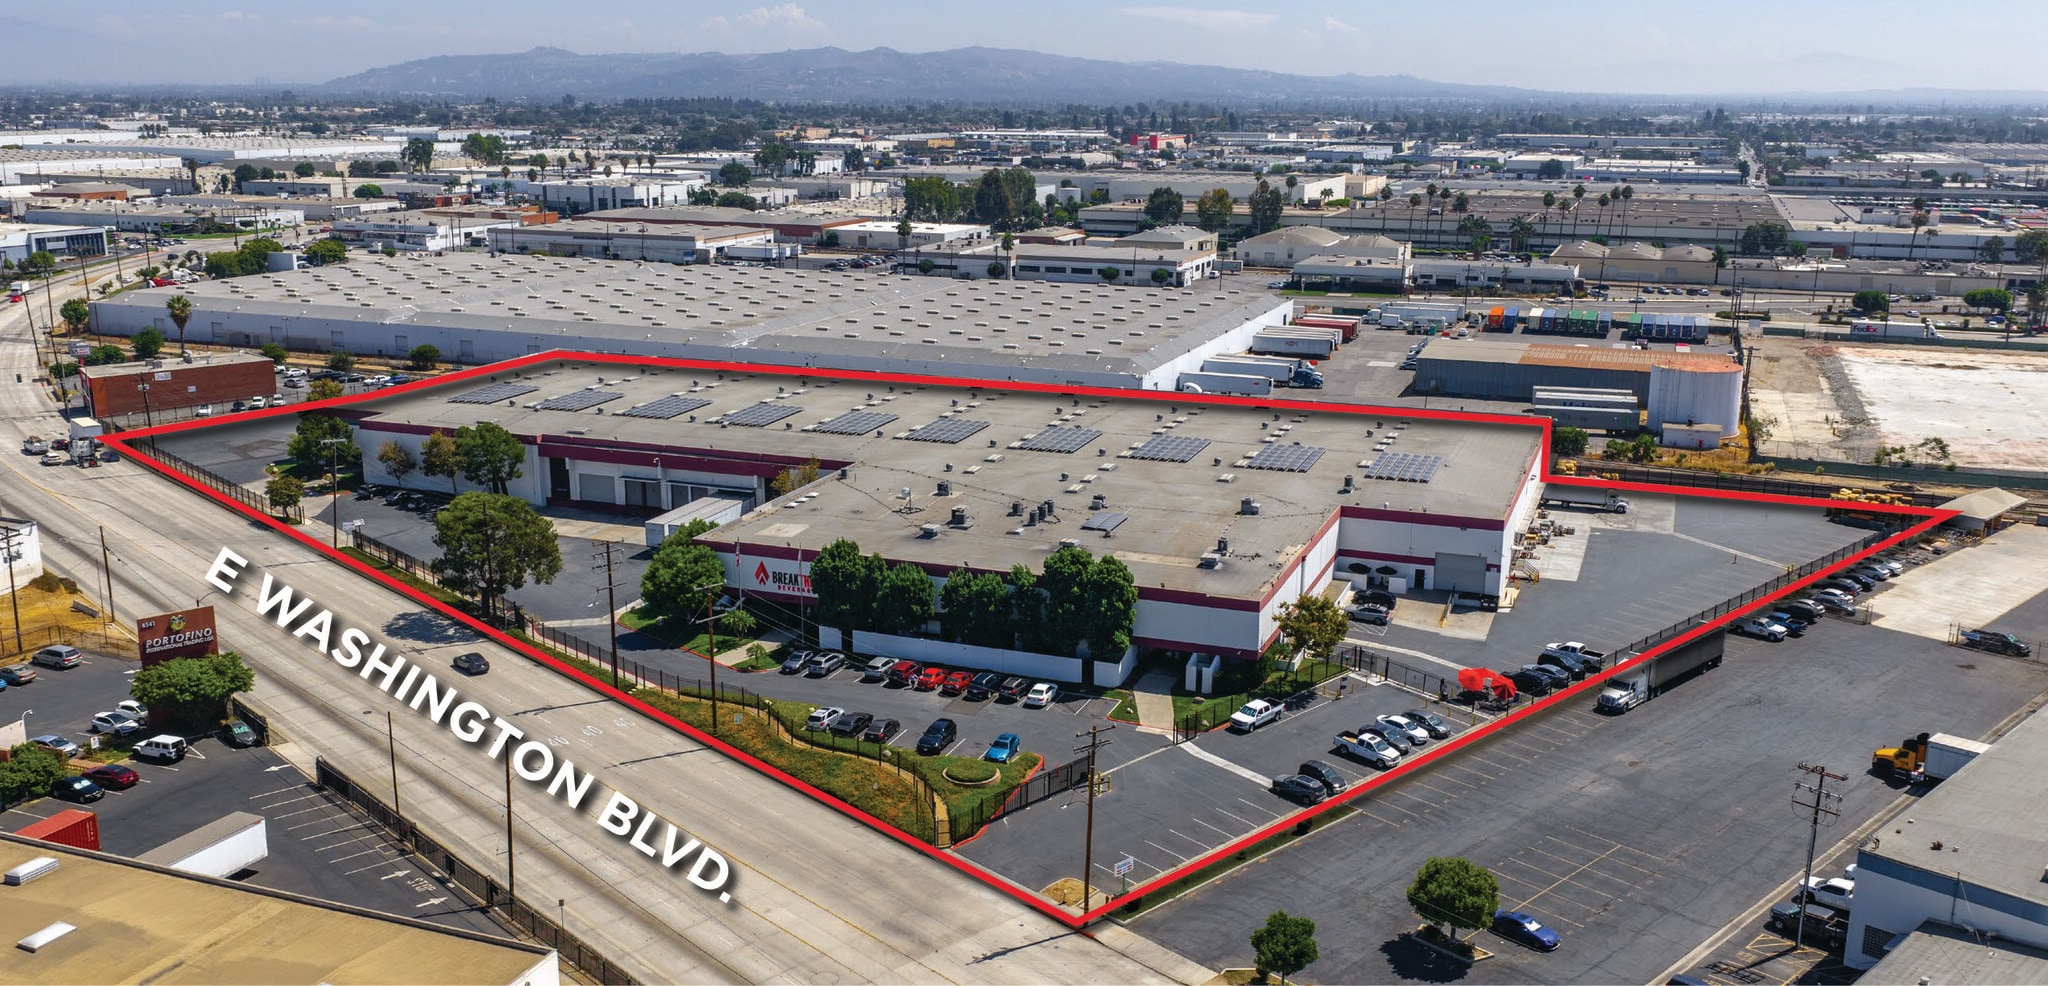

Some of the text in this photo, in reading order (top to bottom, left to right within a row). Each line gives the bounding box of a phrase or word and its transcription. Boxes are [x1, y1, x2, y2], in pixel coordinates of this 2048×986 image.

[1853, 324, 1877, 333] FedEx
[778, 584, 812, 594] BEVERAG
[142, 620, 156, 628] 6541
[146, 628, 212, 648] PORTOFINO
[146, 642, 183, 654] INTERNATIONAL
[184, 638, 204, 646] TRADING
[581, 725, 603, 736] 40
[406, 878, 436, 892] STOP
